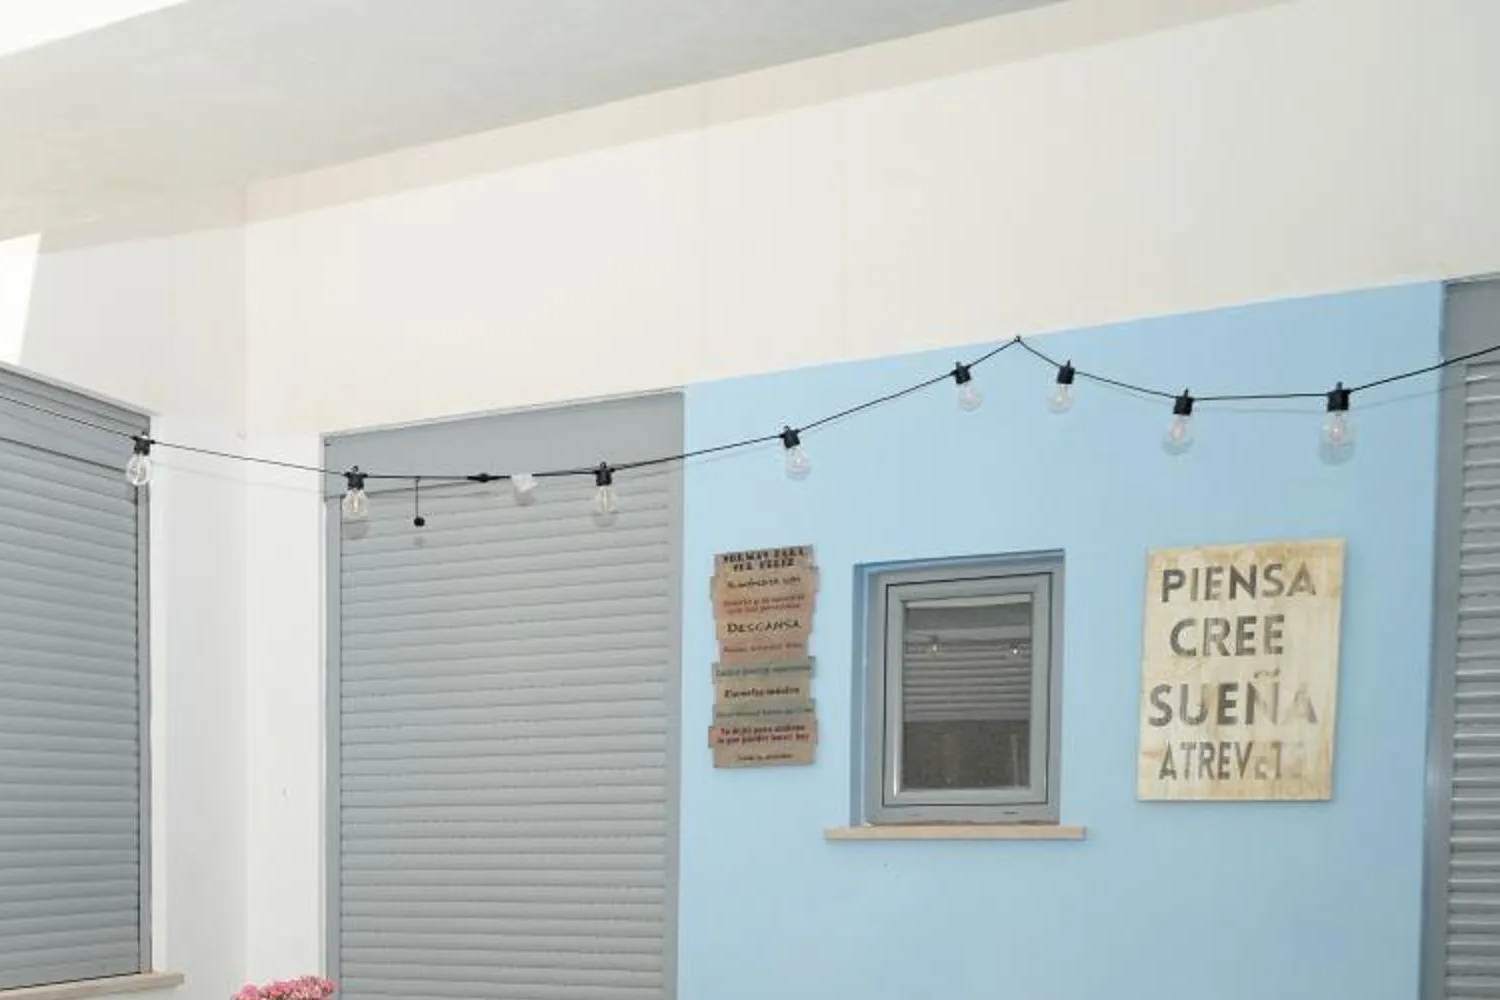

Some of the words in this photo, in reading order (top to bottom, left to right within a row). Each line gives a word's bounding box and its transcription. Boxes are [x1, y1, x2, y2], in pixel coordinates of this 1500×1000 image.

[1161, 562, 1317, 603] PIENSA
[726, 619, 802, 633] DESCANSA
[1169, 613, 1285, 657] CREE
[1148, 667, 1318, 727] SUEÑA
